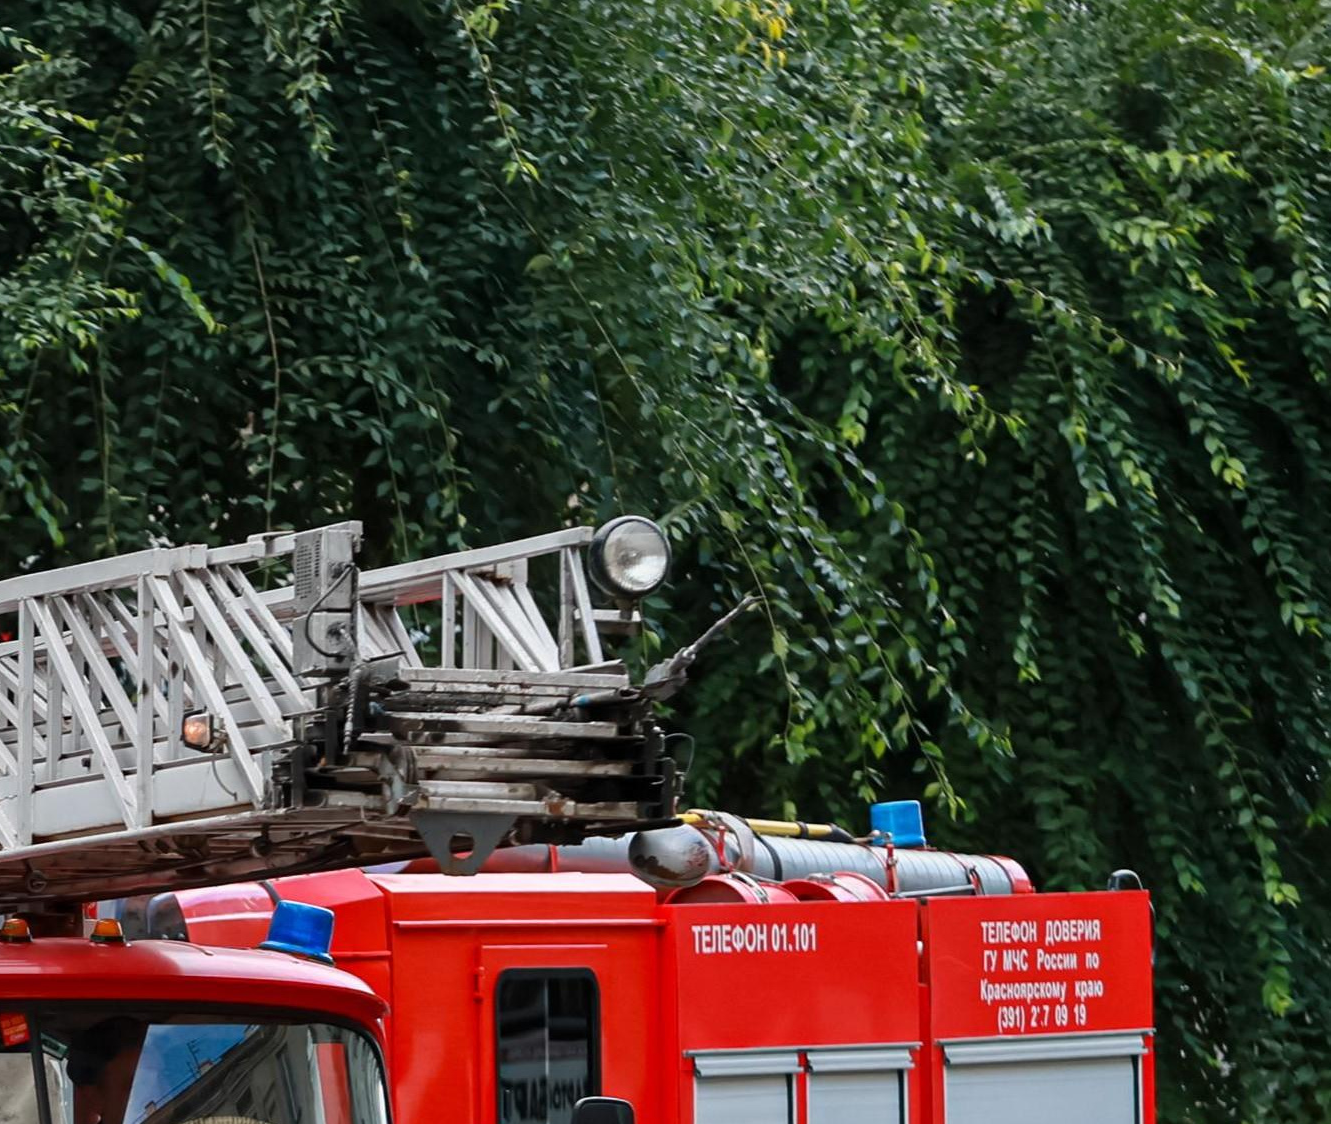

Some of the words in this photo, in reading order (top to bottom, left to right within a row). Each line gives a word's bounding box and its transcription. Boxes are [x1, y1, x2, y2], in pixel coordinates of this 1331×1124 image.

[691, 922, 767, 953] ТЕЛЕФОН
[771, 922, 816, 952] 01.101
[981, 920, 1037, 943] ТЕЛЕФОН
[1045, 919, 1101, 946] ДОВЕРИЯ
[983, 949, 997, 972] ГУ
[1002, 948, 1028, 972] МЧС
[1036, 948, 1077, 971] России
[1085, 952, 1100, 970] по
[980, 979, 1067, 1006] Красноярскому
[1074, 980, 1104, 1002] краю
[998, 1005, 1025, 1033] (391)
[1055, 1004, 1068, 1026] 09
[1073, 1003, 1087, 1026] 19
